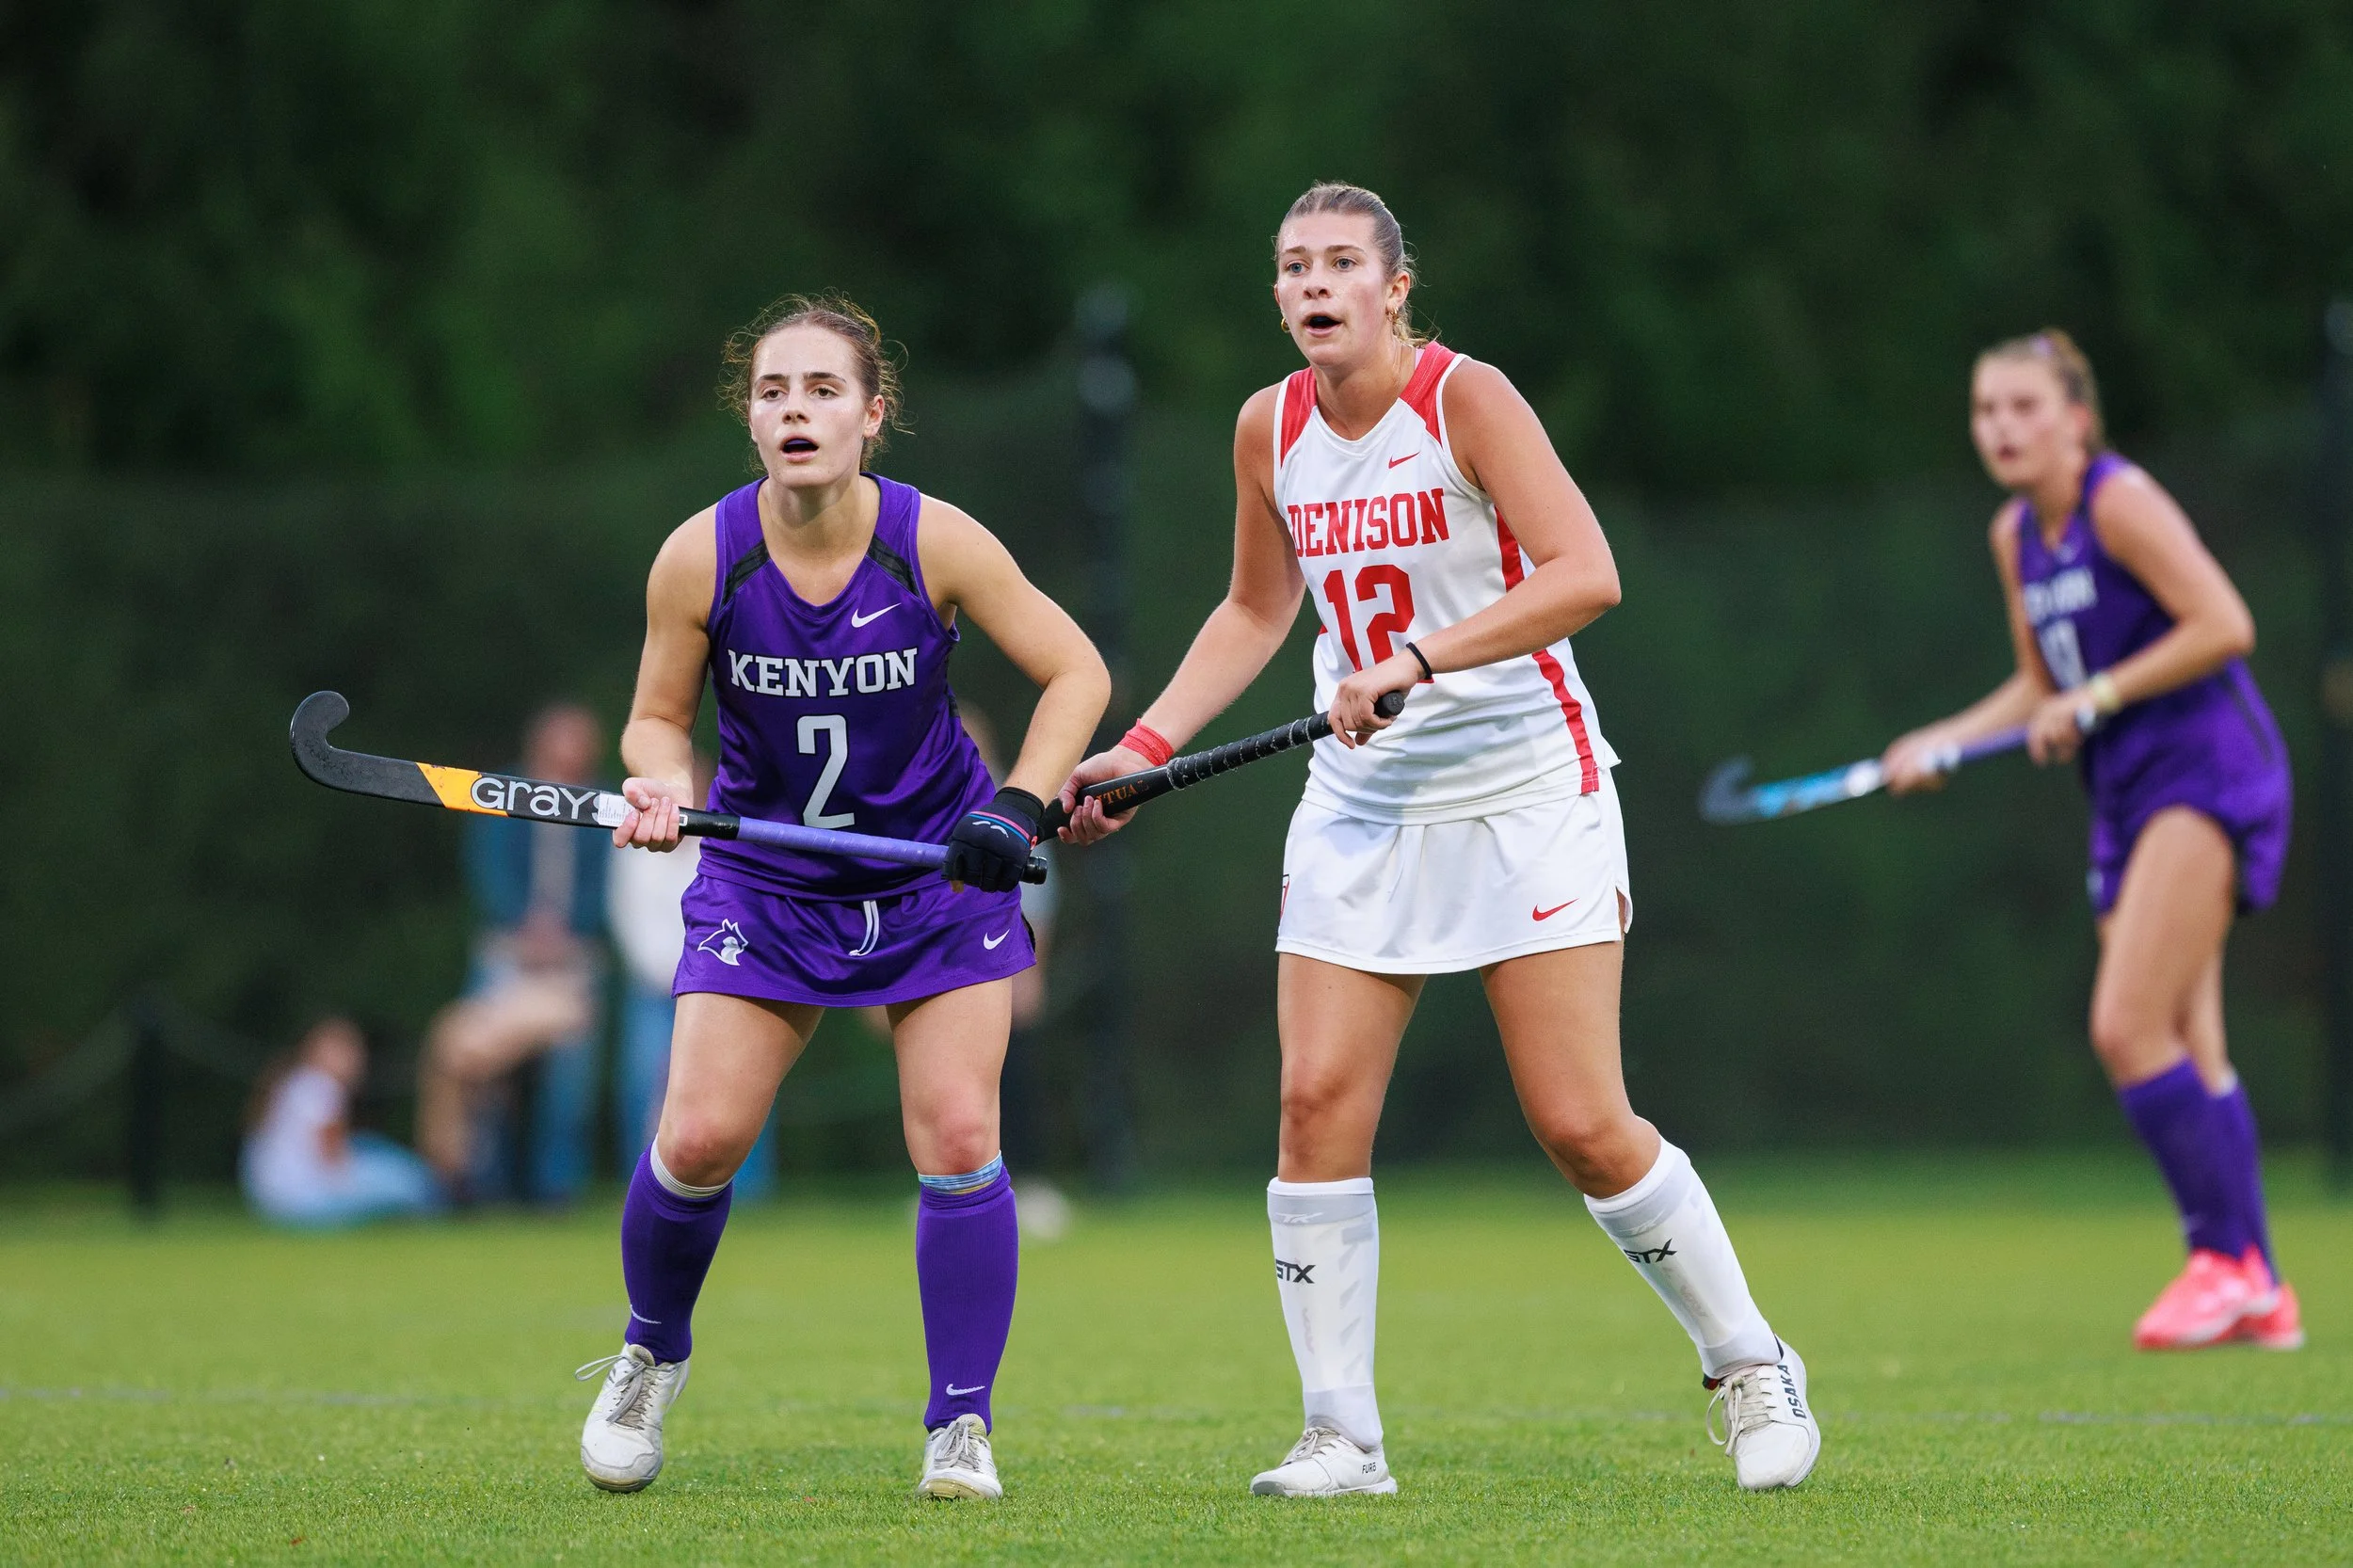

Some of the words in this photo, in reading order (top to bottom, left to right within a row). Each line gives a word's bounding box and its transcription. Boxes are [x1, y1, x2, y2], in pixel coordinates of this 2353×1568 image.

[1287, 488, 1450, 557] DENISON
[1323, 564, 1415, 673] 12
[727, 647, 919, 698] KENYON
[796, 713, 855, 829] 2
[1776, 1364, 1808, 1420] OSAKA
